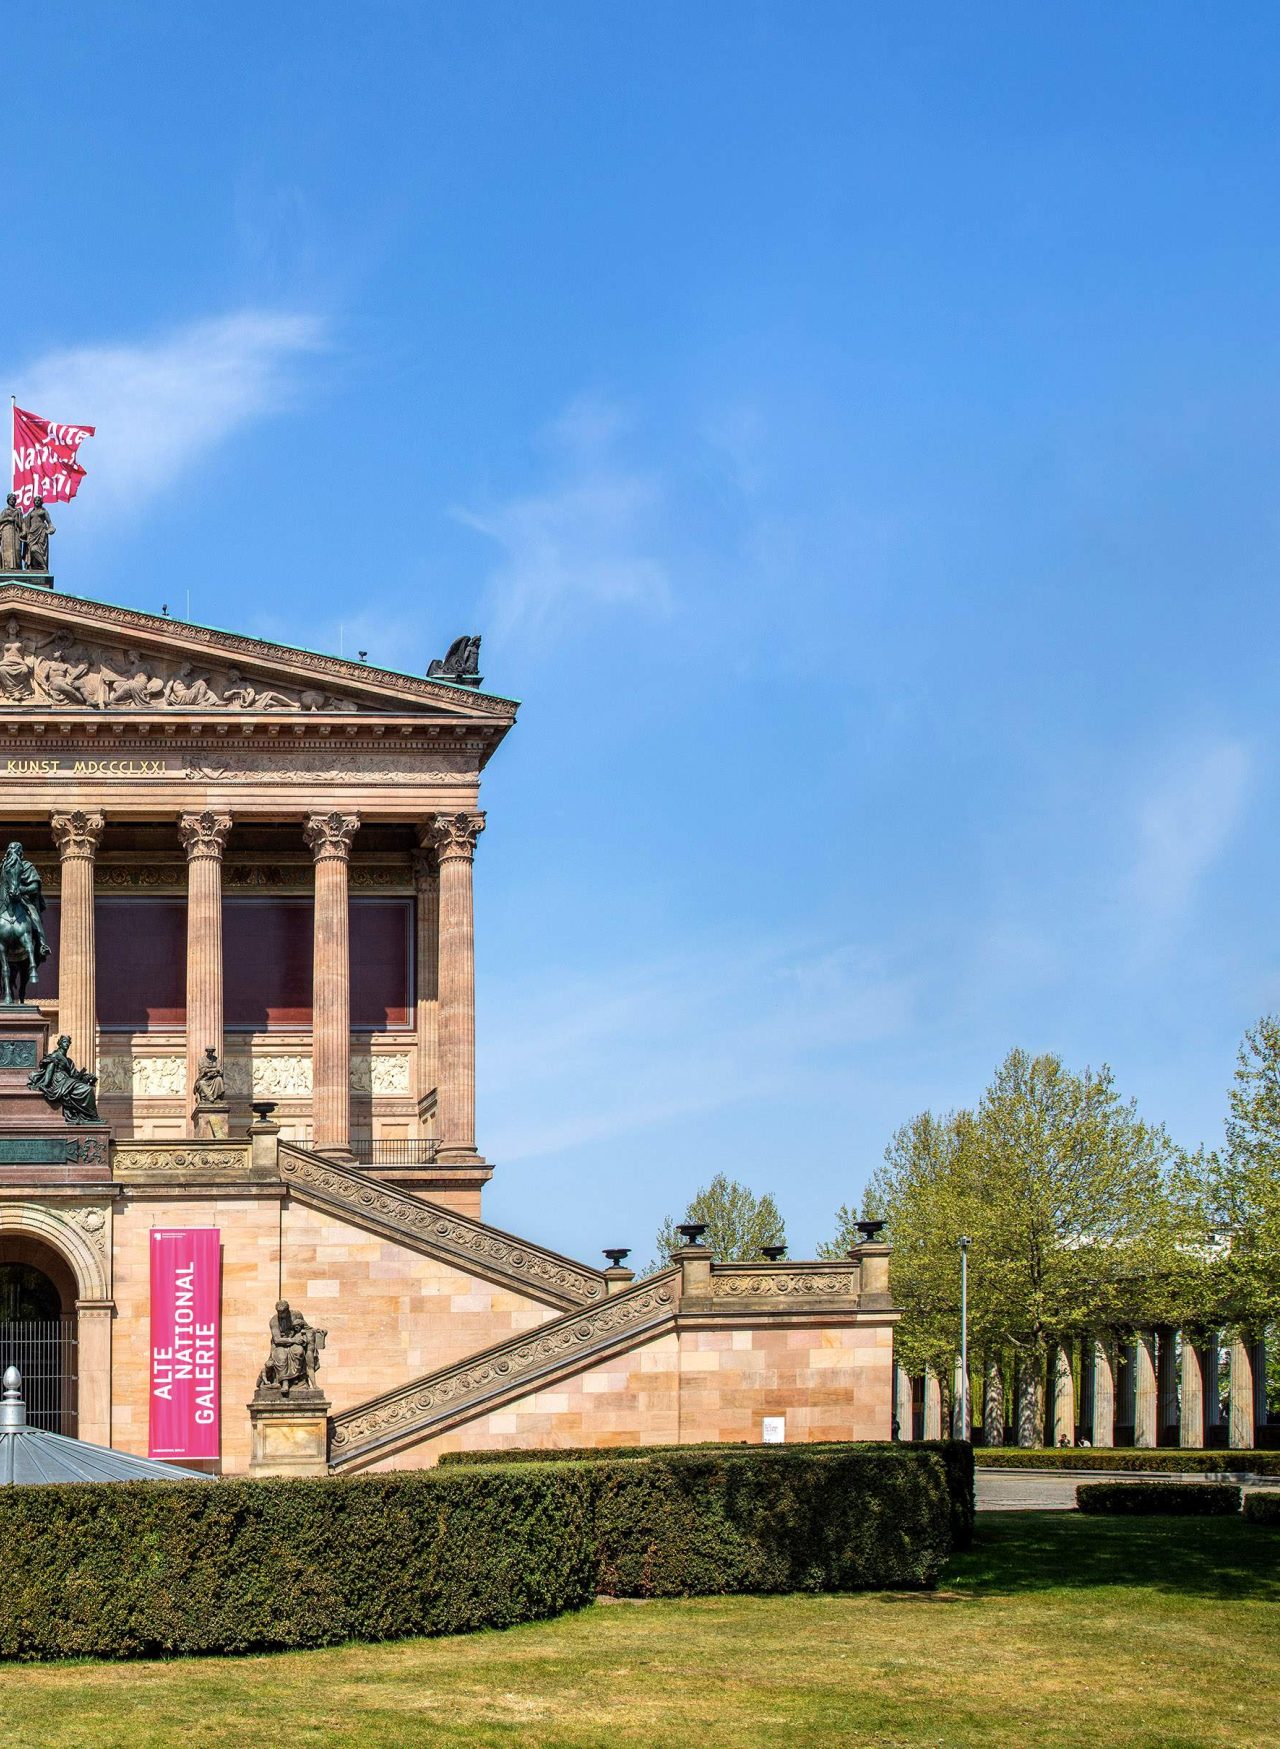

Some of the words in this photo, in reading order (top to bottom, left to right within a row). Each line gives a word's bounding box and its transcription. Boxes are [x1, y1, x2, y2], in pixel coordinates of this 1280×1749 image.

[42, 422, 90, 446] Alte
[7, 760, 60, 773] KUNST
[73, 760, 166, 774] MDCCCLXXI
[174, 1261, 194, 1379] NATIONAL
[153, 1346, 173, 1400] ALTE
[194, 1322, 215, 1424] GALERIE
